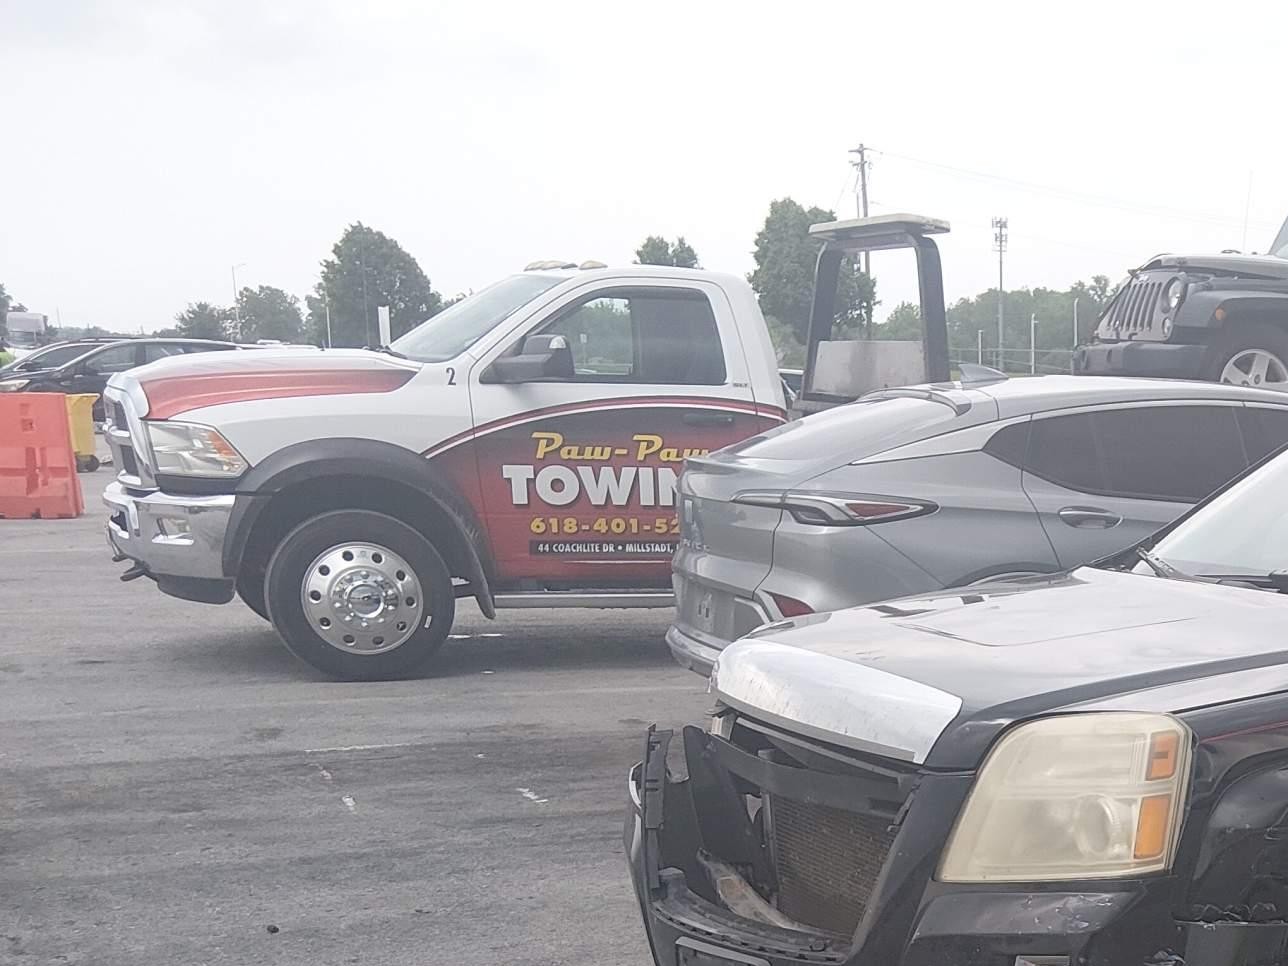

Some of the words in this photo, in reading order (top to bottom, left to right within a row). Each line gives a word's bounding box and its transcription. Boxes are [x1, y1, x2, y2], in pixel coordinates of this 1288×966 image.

[446, 367, 457, 386] 2
[537, 543, 550, 553] 44
[552, 543, 600, 553] COACHLITE
[602, 543, 615, 553] DR
[625, 543, 674, 554] MILLSTADT,
